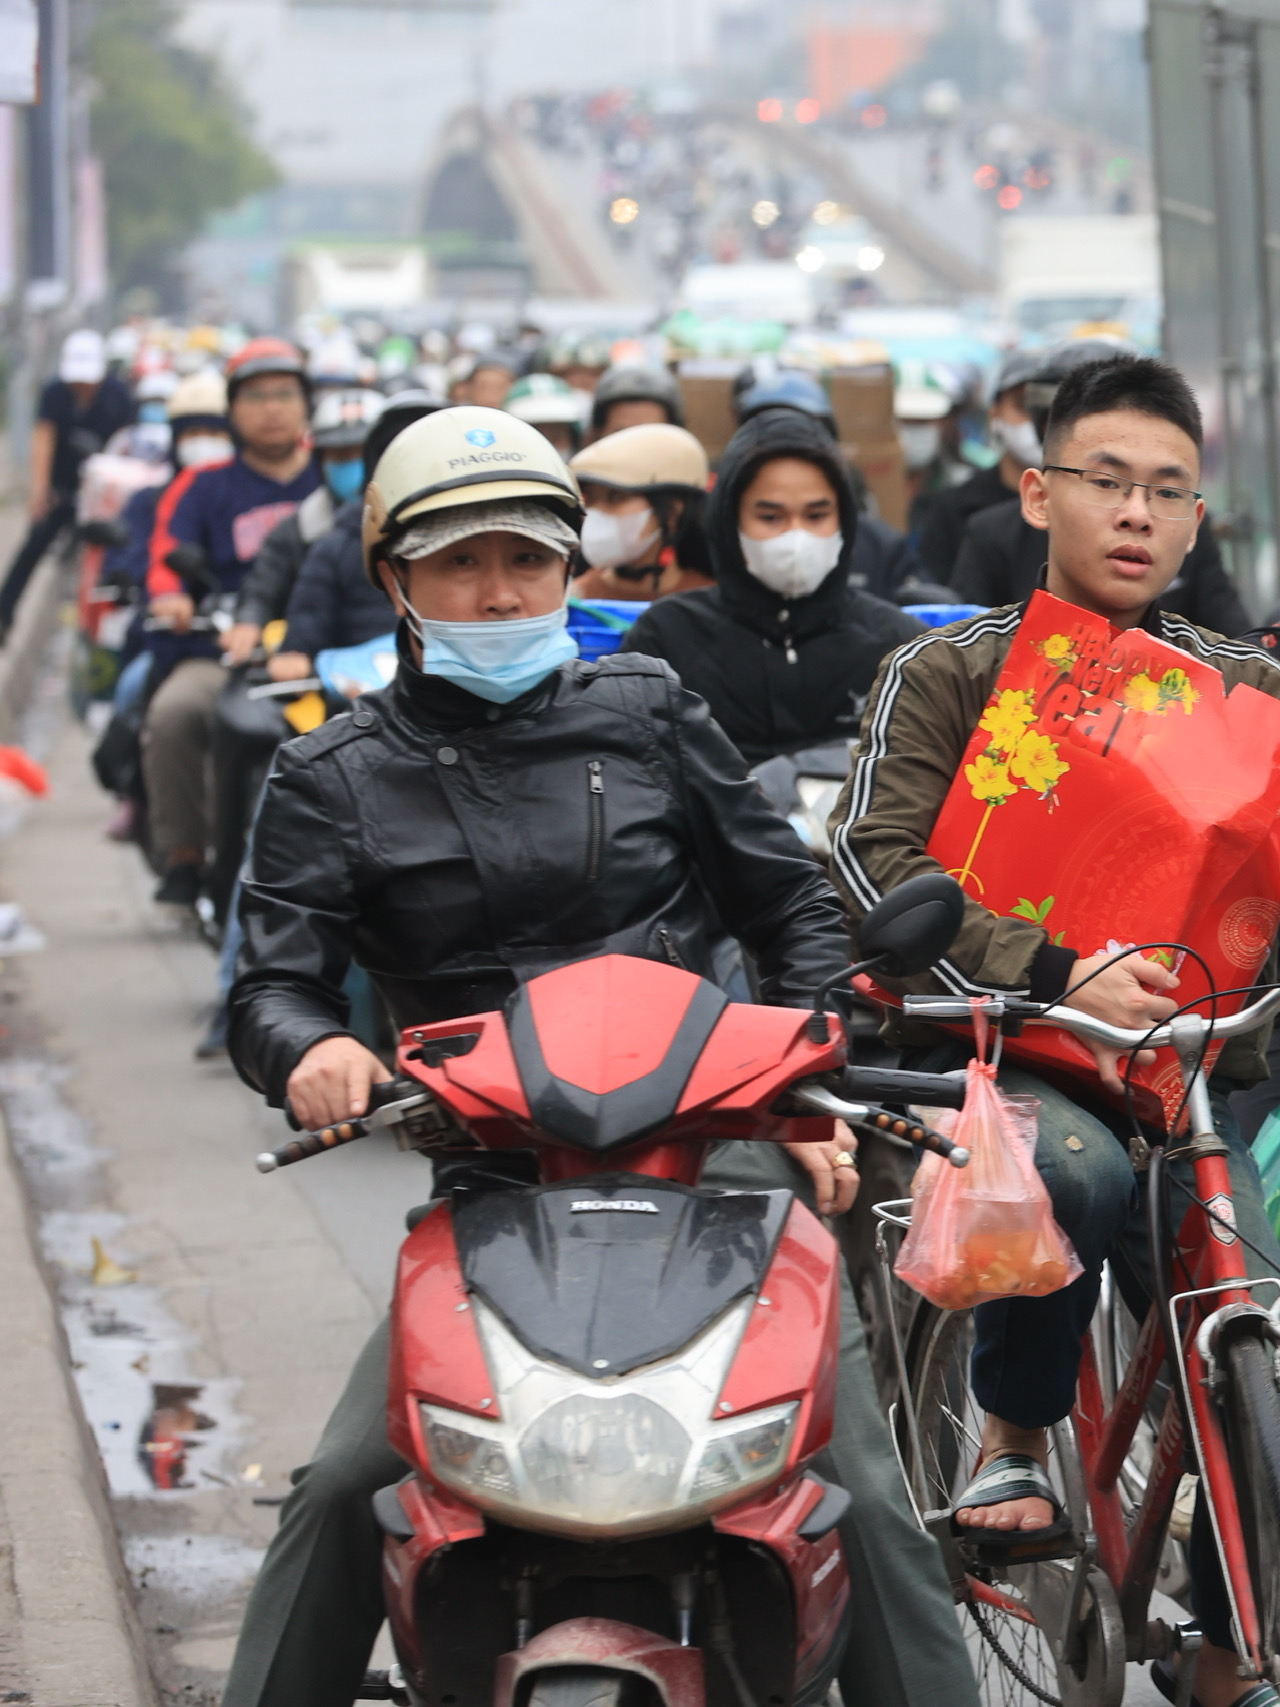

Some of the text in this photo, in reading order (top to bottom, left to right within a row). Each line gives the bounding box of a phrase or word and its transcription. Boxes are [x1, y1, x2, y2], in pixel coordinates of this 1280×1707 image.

[448, 451, 523, 469] PIAGGIO
[1034, 660, 1163, 766] Year
[569, 1200, 660, 1214] HONDA
